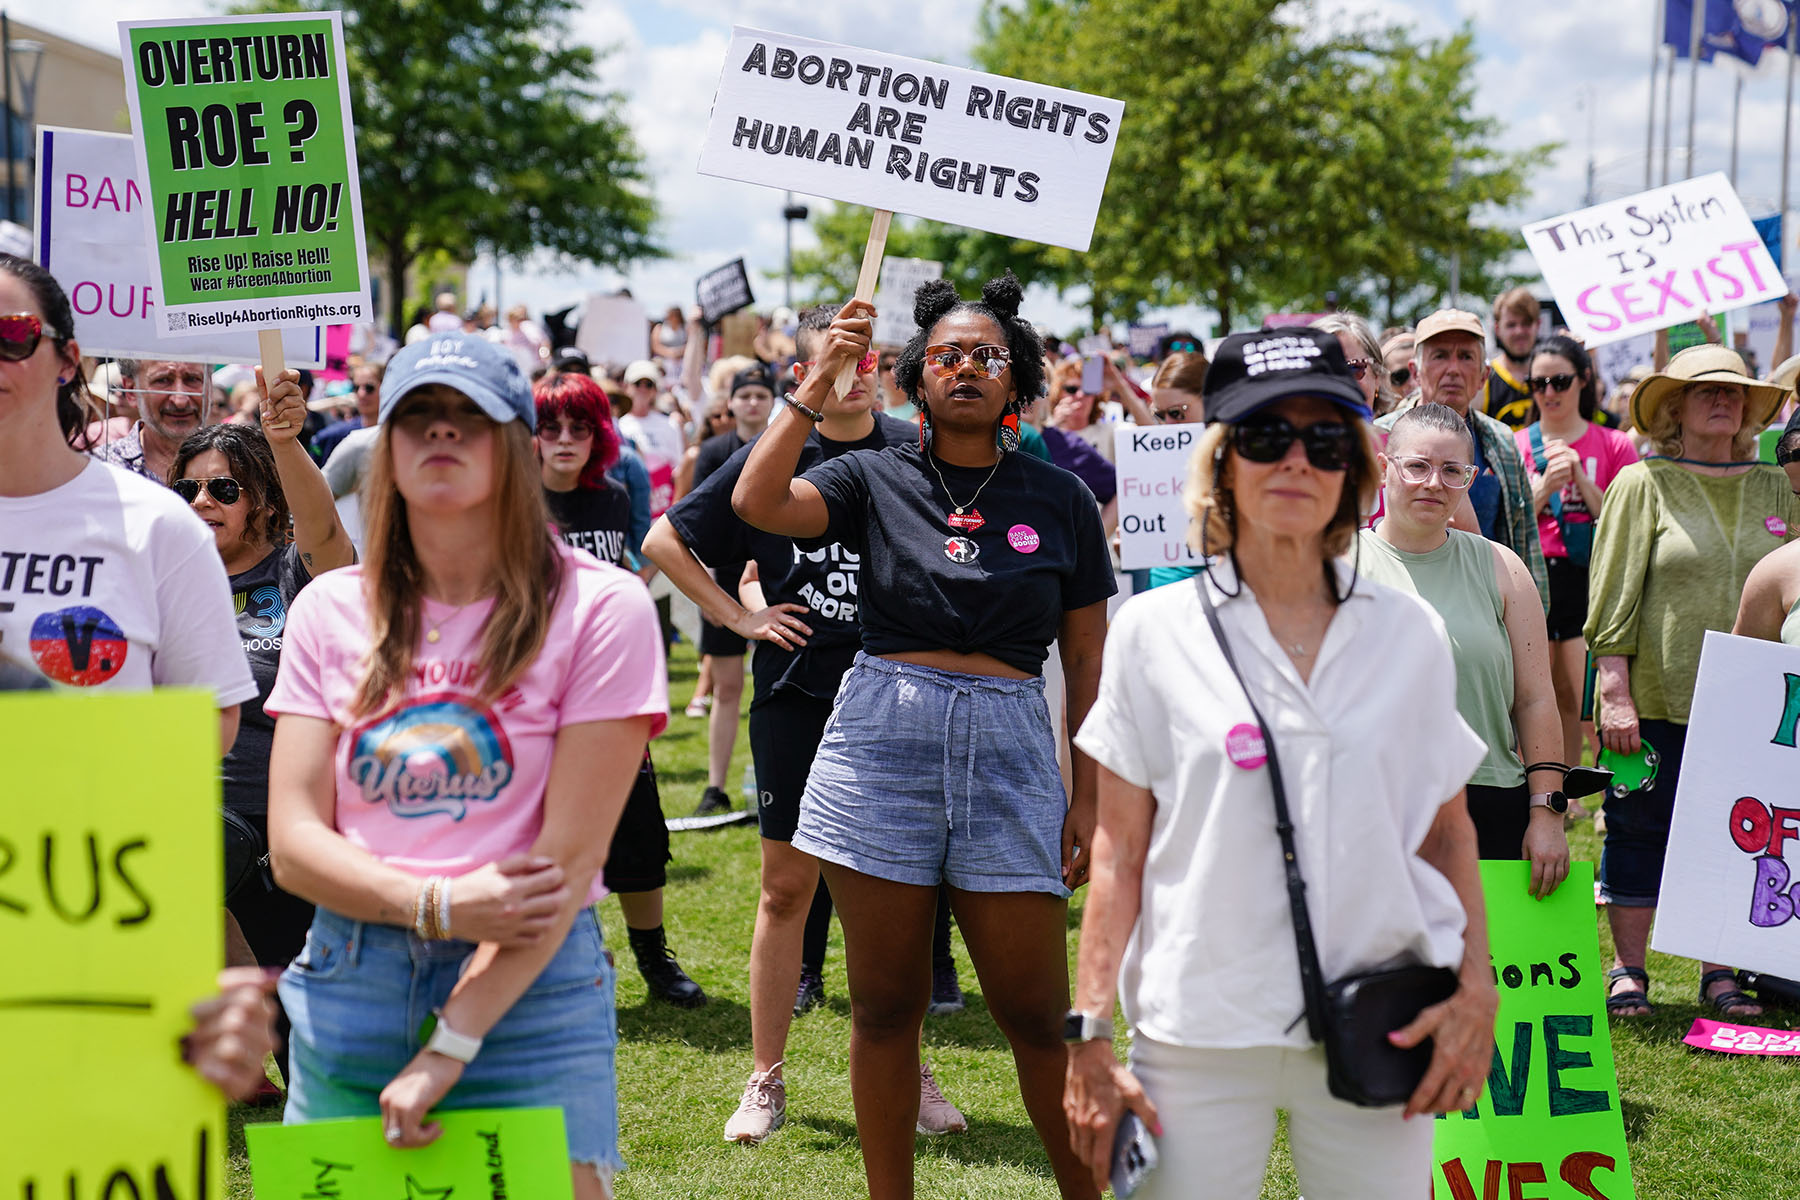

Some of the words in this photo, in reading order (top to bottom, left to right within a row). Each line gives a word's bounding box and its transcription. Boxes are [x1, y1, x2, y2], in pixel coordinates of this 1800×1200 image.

[138, 33, 331, 88] OVERTURN
[742, 42, 950, 110] ABORTION
[966, 85, 1111, 144] RIGHTS
[165, 101, 270, 171] ROE
[283, 98, 319, 164] ?
[846, 101, 927, 145] ARE
[732, 115, 875, 169] HUMAN
[885, 143, 1041, 203] RIGHTS
[163, 187, 260, 244] HELL
[271, 182, 343, 236] NO!
[1534, 221, 1614, 252] This
[1625, 195, 1726, 245] System
[187, 256, 221, 274] Rise
[224, 252, 249, 272] Up!
[252, 250, 294, 269] Raise
[297, 247, 331, 267] Hell!
[190, 276, 223, 292] Wear
[227, 268, 332, 289] #Green4Abortion
[1607, 247, 1657, 274] IS
[1576, 240, 1768, 333] SEXIST
[187, 303, 362, 327] RiseUp4AbortionRights.org
[1133, 430, 1192, 452] Keep
[563, 530, 624, 561] TERUS
[1123, 513, 1167, 534] Out
[797, 582, 859, 621] ABOR
[1435, 1014, 1613, 1120] VE
[1430, 1150, 1616, 1200] VES
